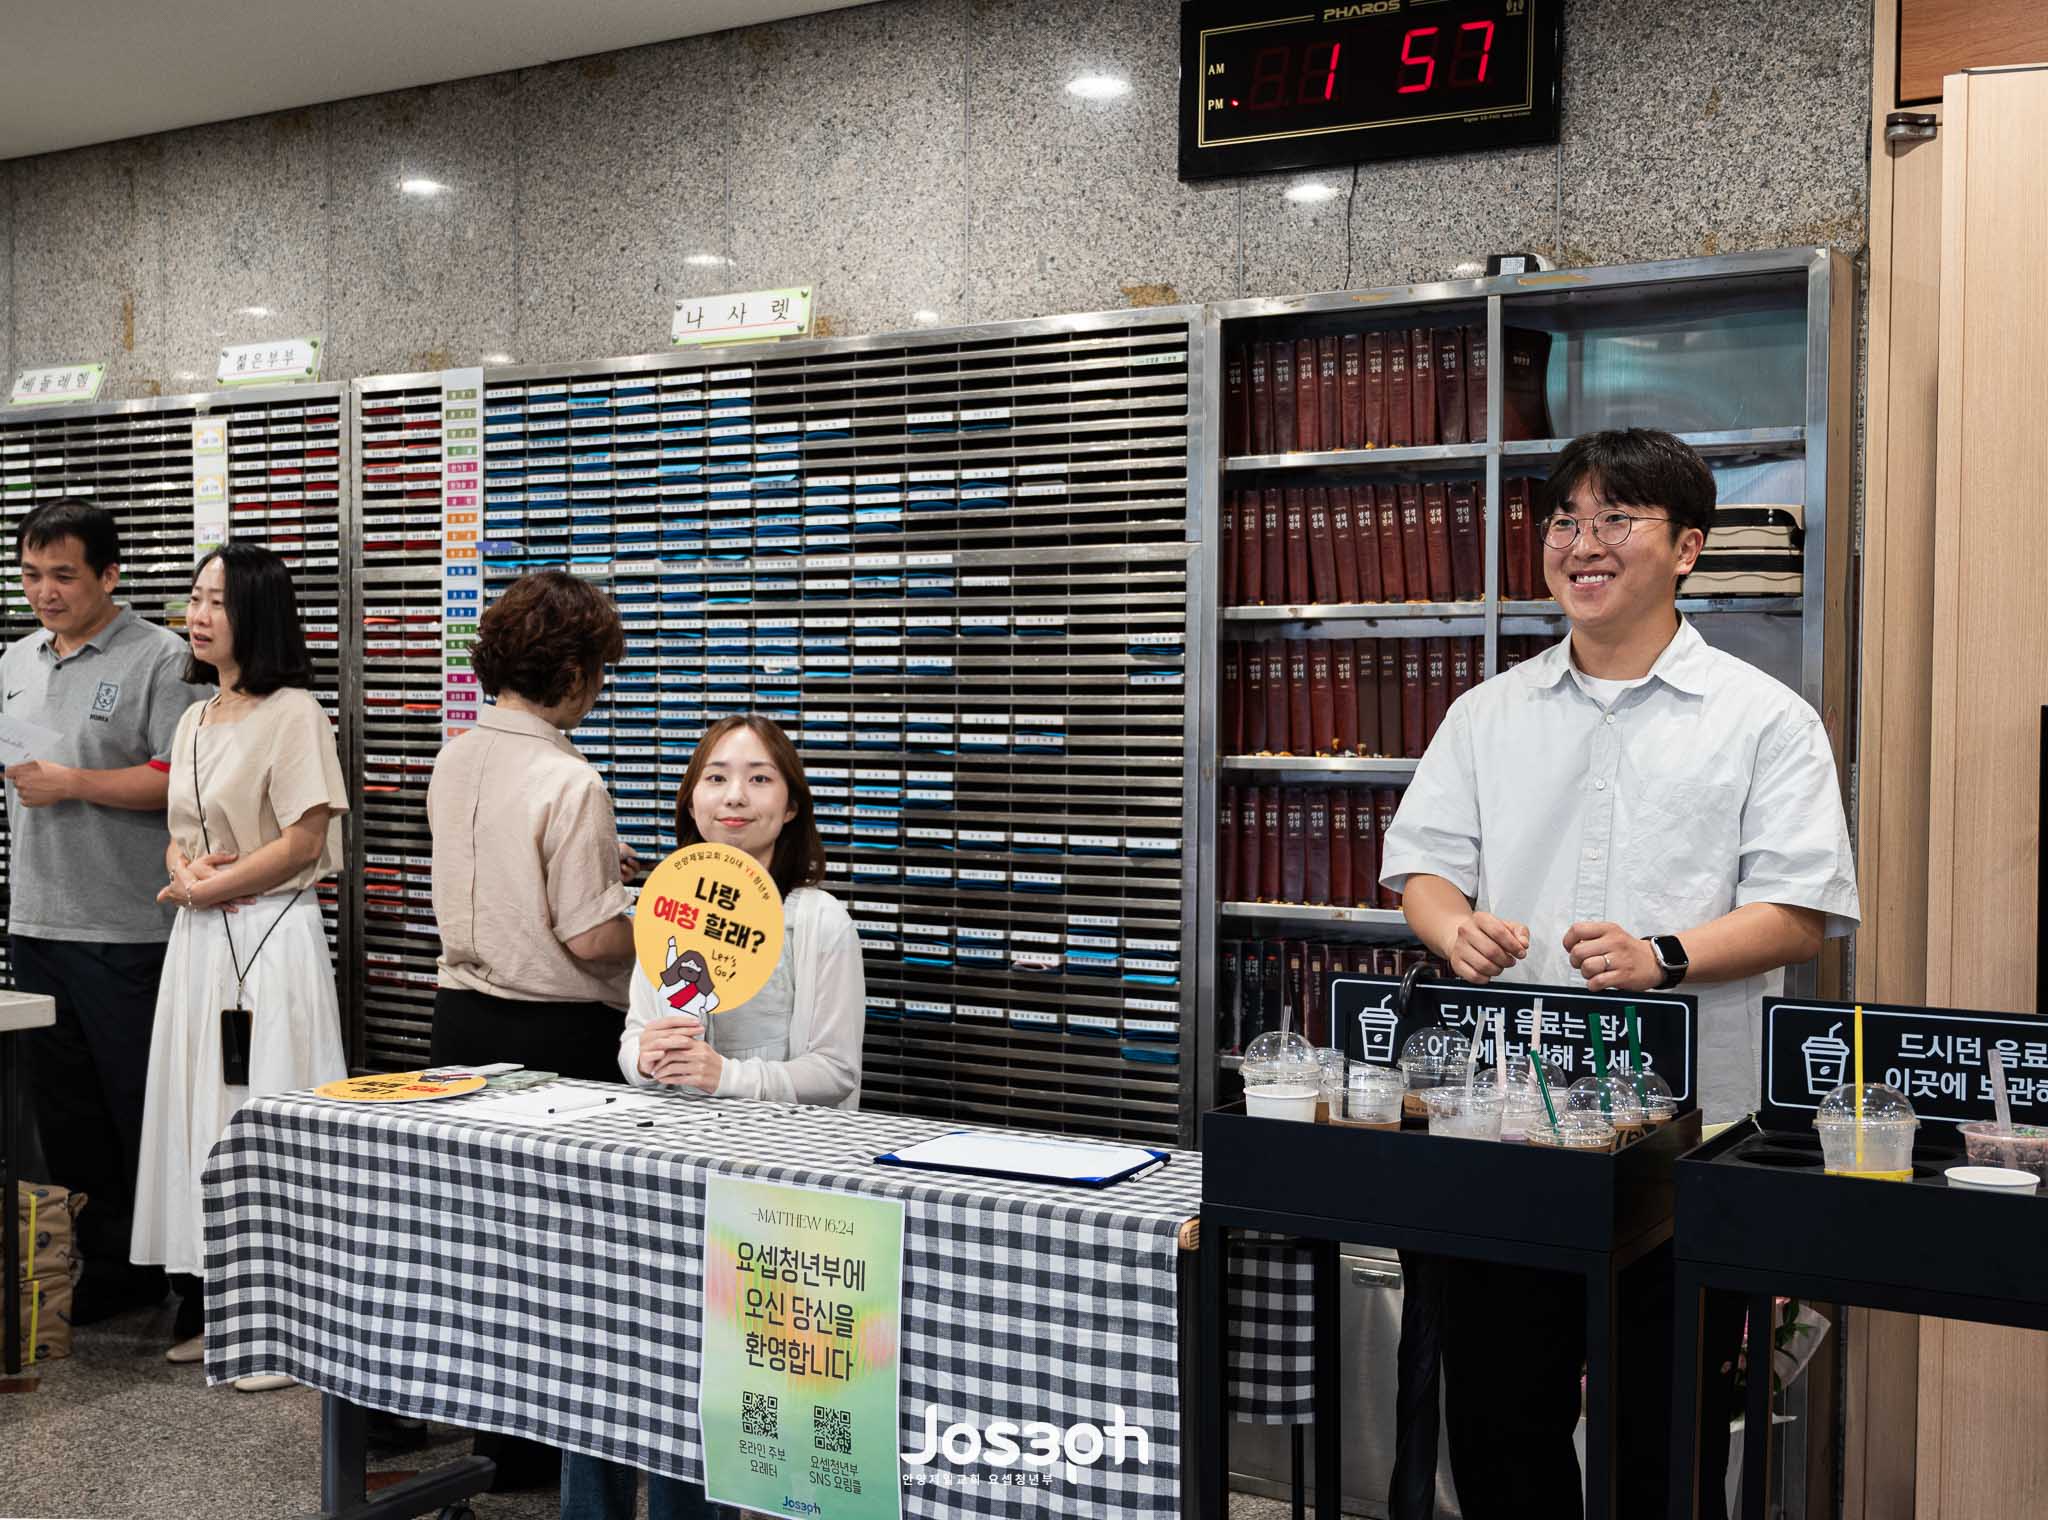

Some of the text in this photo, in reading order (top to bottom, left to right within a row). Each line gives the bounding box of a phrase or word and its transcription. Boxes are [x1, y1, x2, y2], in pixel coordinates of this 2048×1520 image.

[1322, 0, 1400, 21] PHAROS
[1208, 64, 1224, 75] AM
[1324, 20, 1495, 101] 1 57
[1208, 99, 1224, 110] PM
[686, 298, 790, 328] 나사렛
[724, 854, 743, 869] 20대
[695, 876, 741, 911] 나랑
[654, 896, 766, 954] 예청 할래?
[712, 949, 737, 968] Let's
[714, 965, 737, 982] Go!
[1514, 1008, 1586, 1039] 음료는
[1897, 1033, 1982, 1066] 드시던
[1885, 1067, 1967, 1101] 이곳에
[824, 1218, 855, 1236] 16:24
[736, 1242, 866, 1292] 요셉청년부에
[745, 1288, 855, 1339] 오신 당신을
[746, 1331, 854, 1382] 환영합니다
[739, 1439, 787, 1462] 온라인 주보
[750, 1459, 778, 1478] 요레터
[810, 1455, 858, 1477] 요셉청년부
[809, 1471, 831, 1487] SNS
